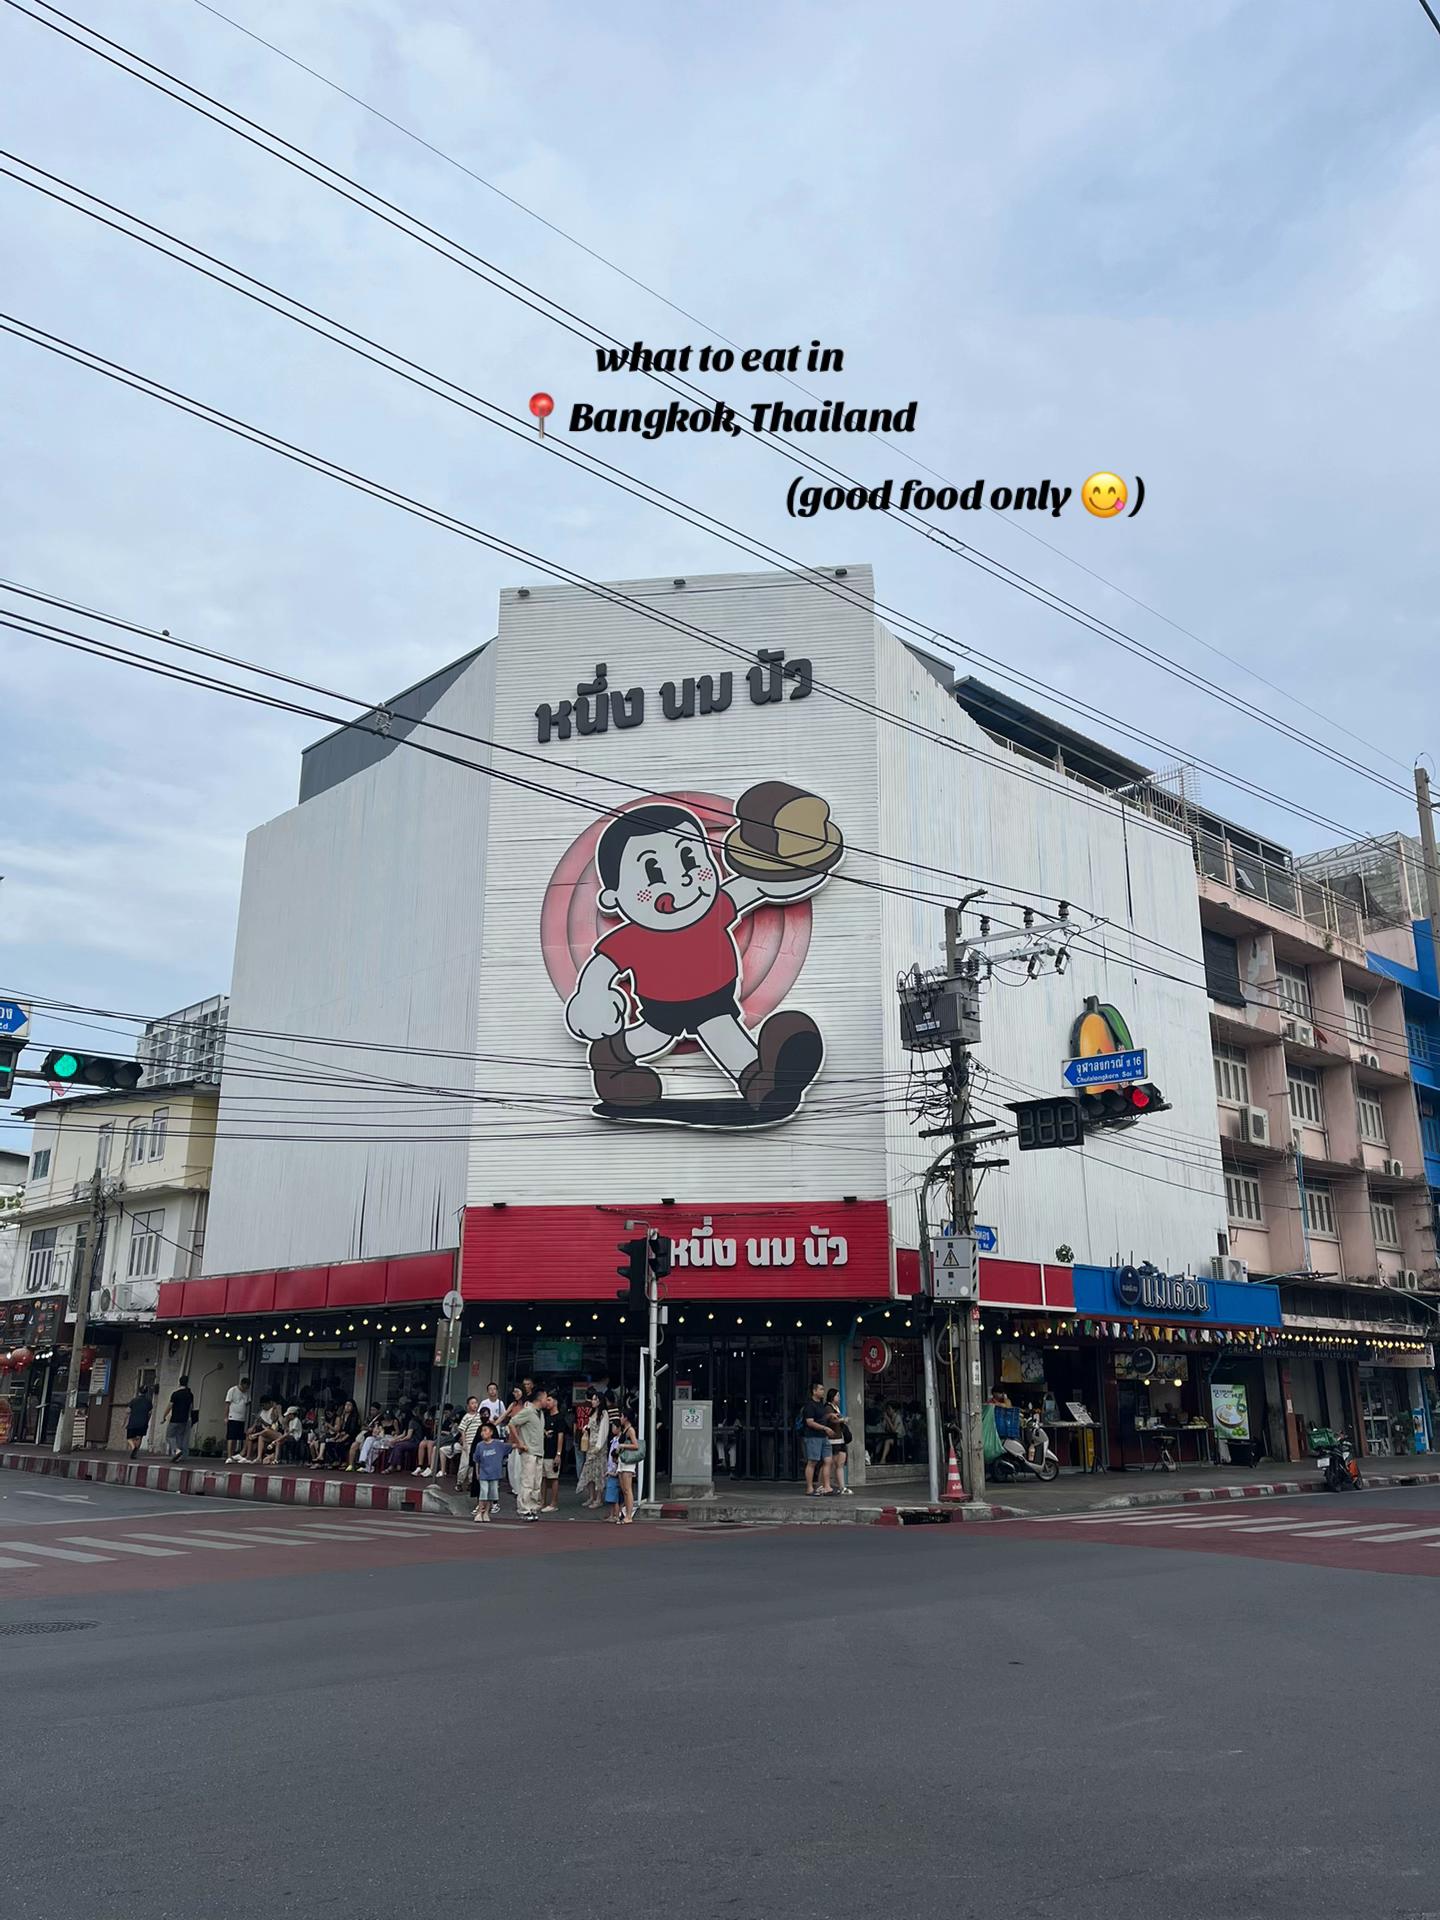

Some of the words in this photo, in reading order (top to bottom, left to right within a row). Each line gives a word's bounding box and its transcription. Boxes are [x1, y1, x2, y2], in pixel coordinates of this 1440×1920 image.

[535, 662, 645, 744] หนึ่ง
[659, 671, 733, 720] นม
[745, 648, 813, 706] นัว
[1076, 1054, 1125, 1077] จุฬาลงกรณ์
[1121, 1070, 1133, 1078] Soi
[745, 1237, 796, 1267] นม
[802, 1225, 849, 1267] นัว
